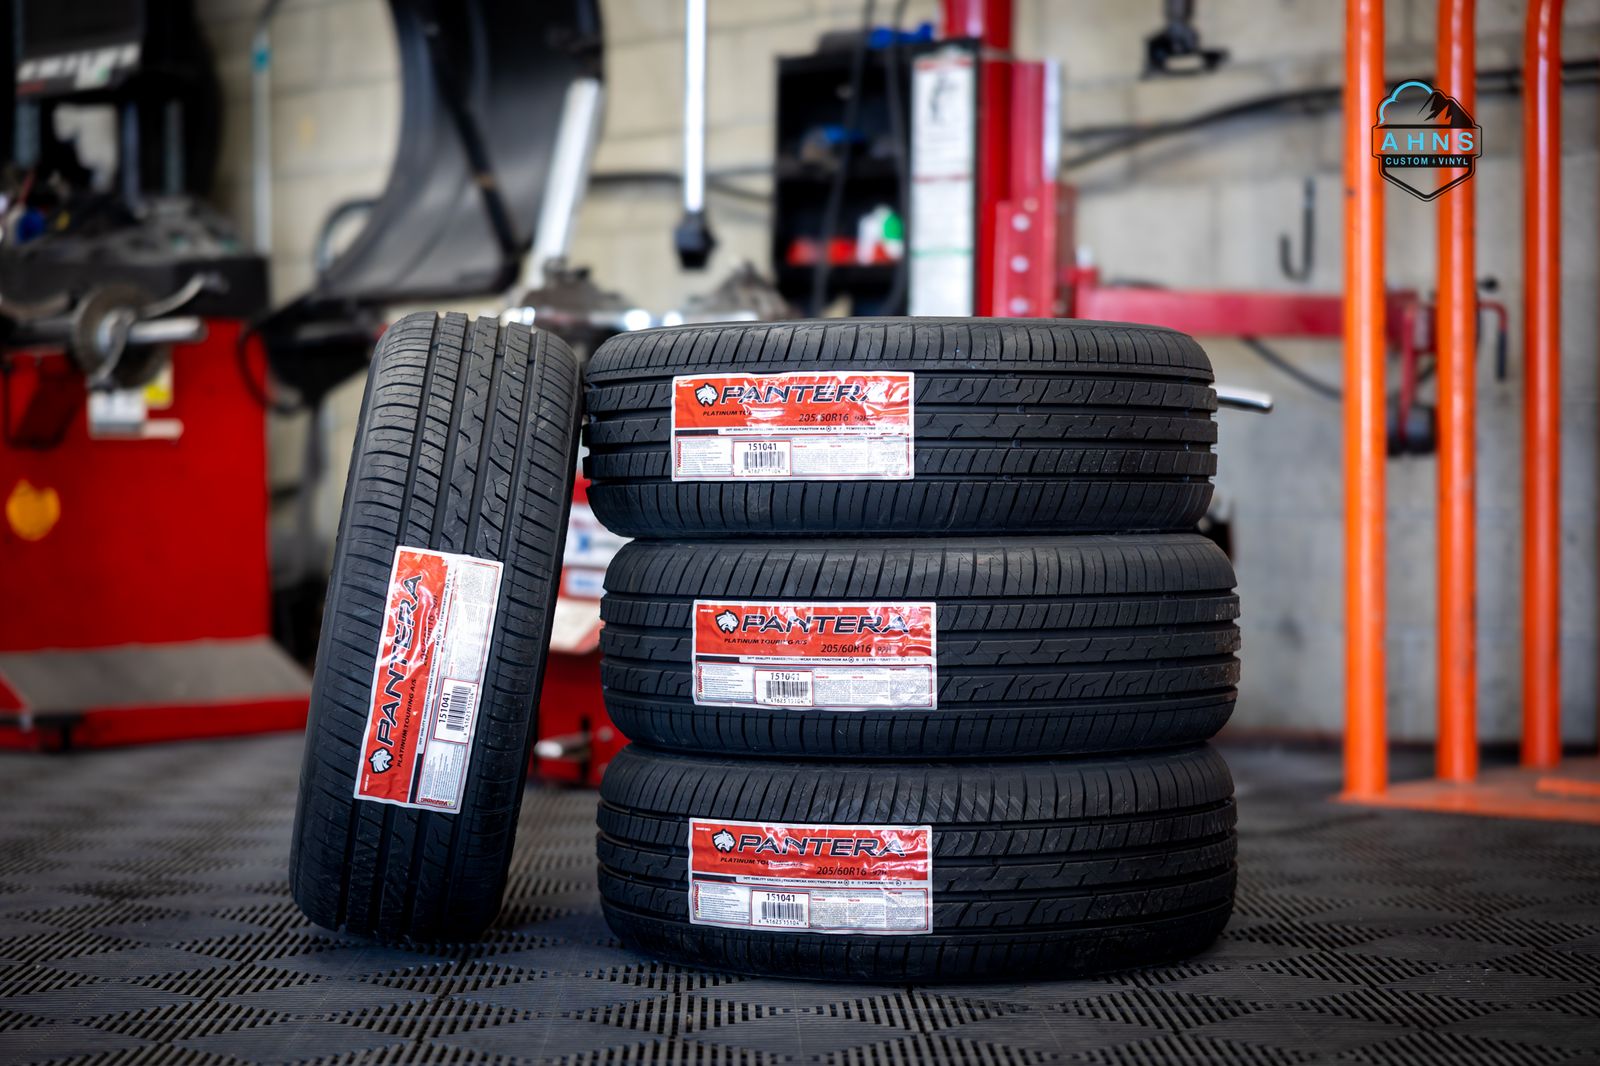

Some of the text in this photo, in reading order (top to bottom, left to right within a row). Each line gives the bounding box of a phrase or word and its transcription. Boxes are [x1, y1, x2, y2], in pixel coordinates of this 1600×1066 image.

[748, 443, 777, 451] 151041
[741, 614, 909, 634] PANTERA
[821, 643, 871, 653] 205/60R16
[376, 575, 422, 747] PANTERA
[439, 692, 451, 723] 151041
[397, 730, 408, 767] PLATINUM
[405, 693, 414, 729] TOURING
[738, 834, 906, 857] PANTERA
[816, 866, 867, 876] 205/60R16
[766, 893, 796, 902] 151041
